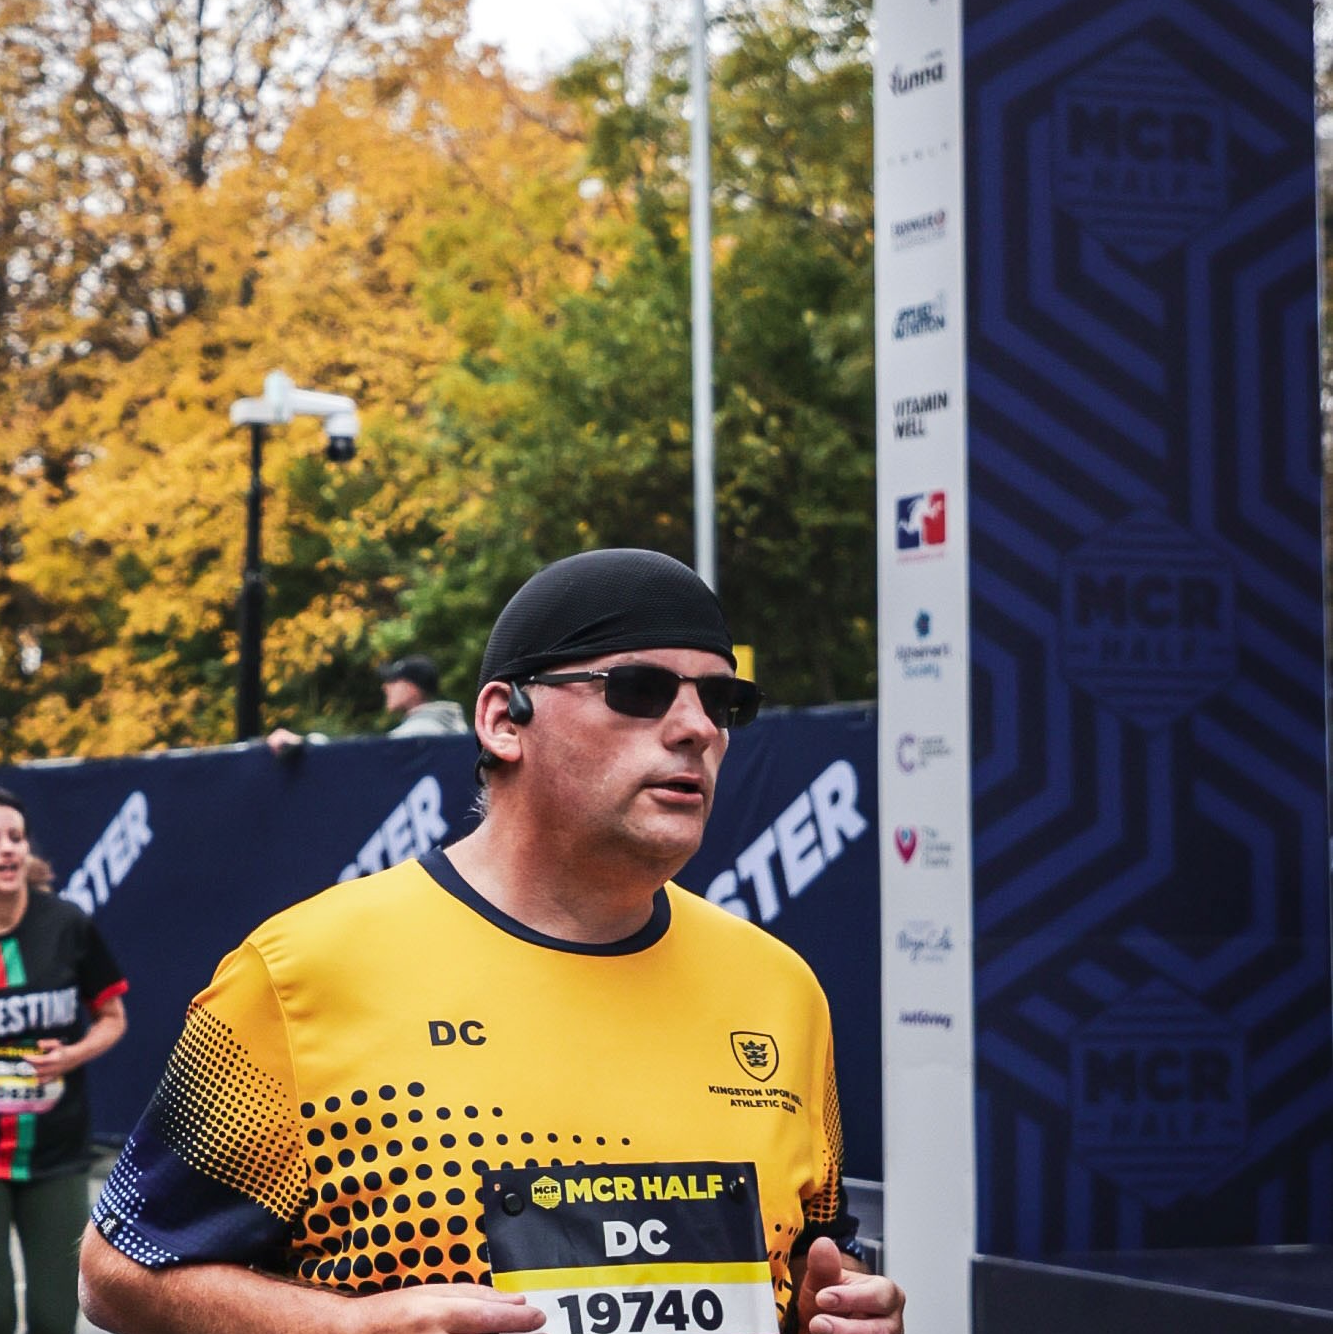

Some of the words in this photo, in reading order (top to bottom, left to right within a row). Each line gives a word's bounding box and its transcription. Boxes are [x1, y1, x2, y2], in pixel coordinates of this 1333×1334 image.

[1069, 104, 1213, 165] MCR
[893, 392, 948, 417] VITAMIN
[894, 419, 926, 439] WELL
[1076, 574, 1220, 631] MCR
[428, 1020, 487, 1046] DC
[1084, 1048, 1232, 1105] MCR
[708, 1085, 762, 1097] KINGSTON
[765, 1088, 790, 1099] UPON
[730, 1098, 780, 1108] ATHLETIC
[533, 1185, 559, 1195] MCR
[565, 1177, 637, 1203] MCR
[641, 1174, 724, 1200] HALF
[603, 1219, 671, 1257] DC
